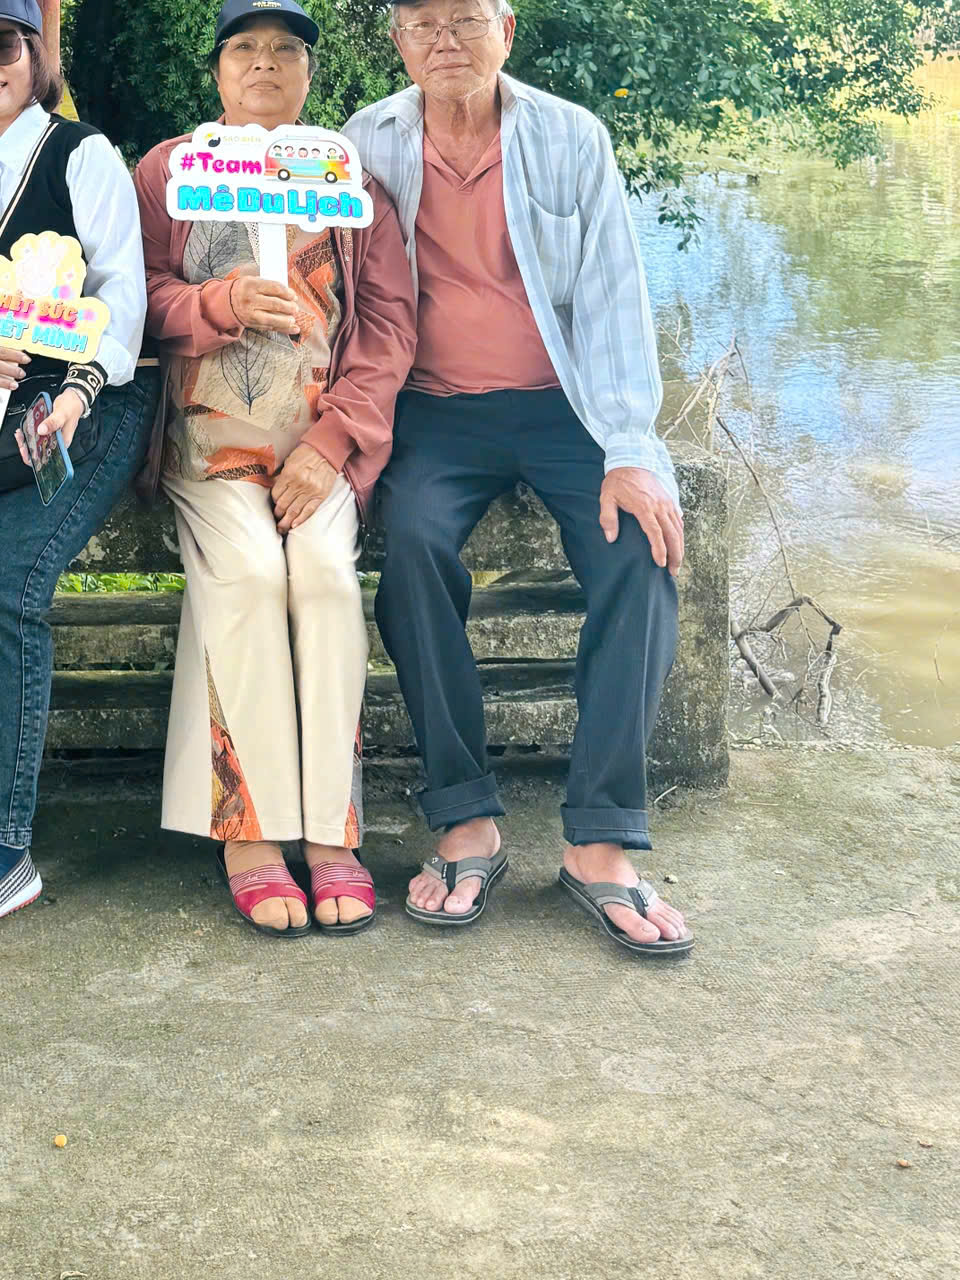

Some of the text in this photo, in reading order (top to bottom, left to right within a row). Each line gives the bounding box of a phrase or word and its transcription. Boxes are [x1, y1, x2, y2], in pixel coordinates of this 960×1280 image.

[180, 151, 262, 174] #Team
[177, 184, 363, 222] Mê Du Lịch
[40, 301, 78, 323] SỨC
[32, 324, 88, 353] MÌNH
